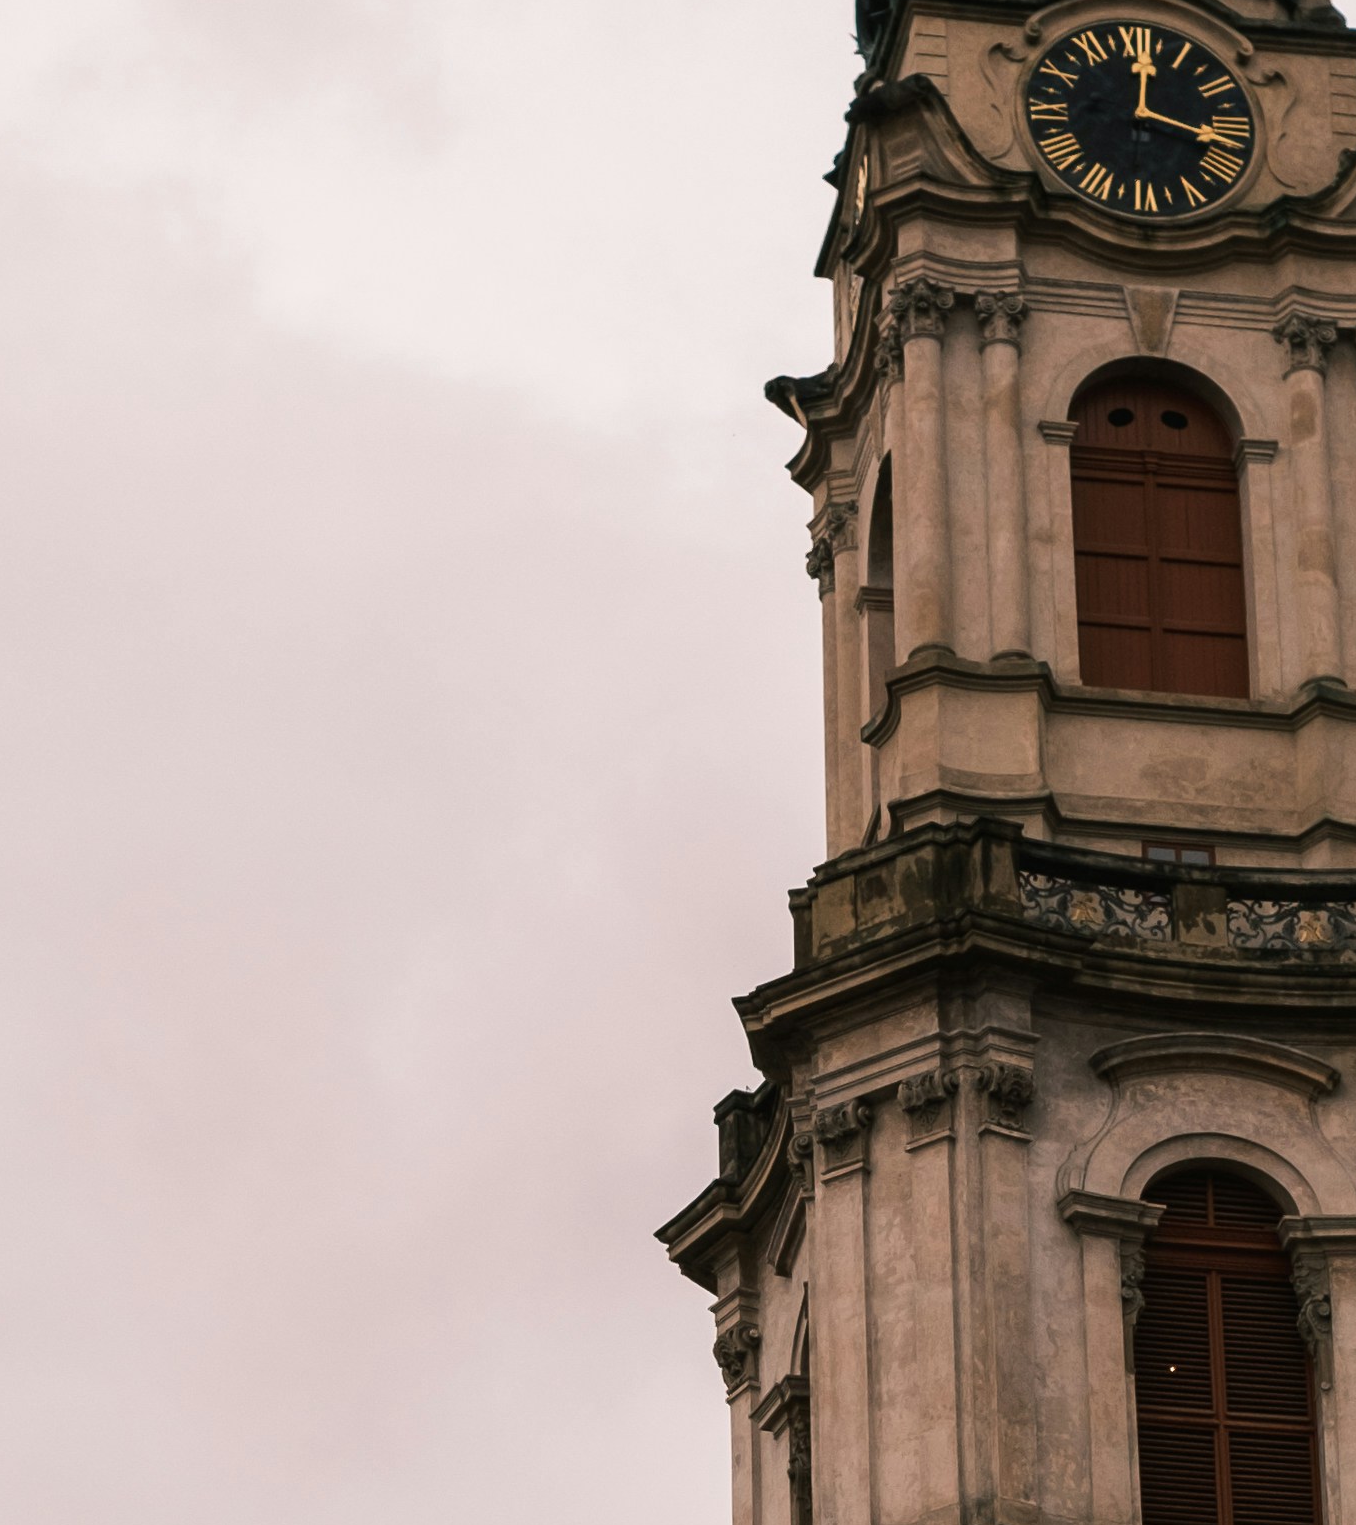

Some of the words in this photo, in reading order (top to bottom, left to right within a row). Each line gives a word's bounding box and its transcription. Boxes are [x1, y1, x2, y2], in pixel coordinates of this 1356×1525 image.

[1071, 30, 1109, 66] XI
[1172, 42, 1192, 69] I
[1039, 59, 1079, 89] X
[1198, 75, 1236, 98] II
[1180, 175, 1208, 207] V
